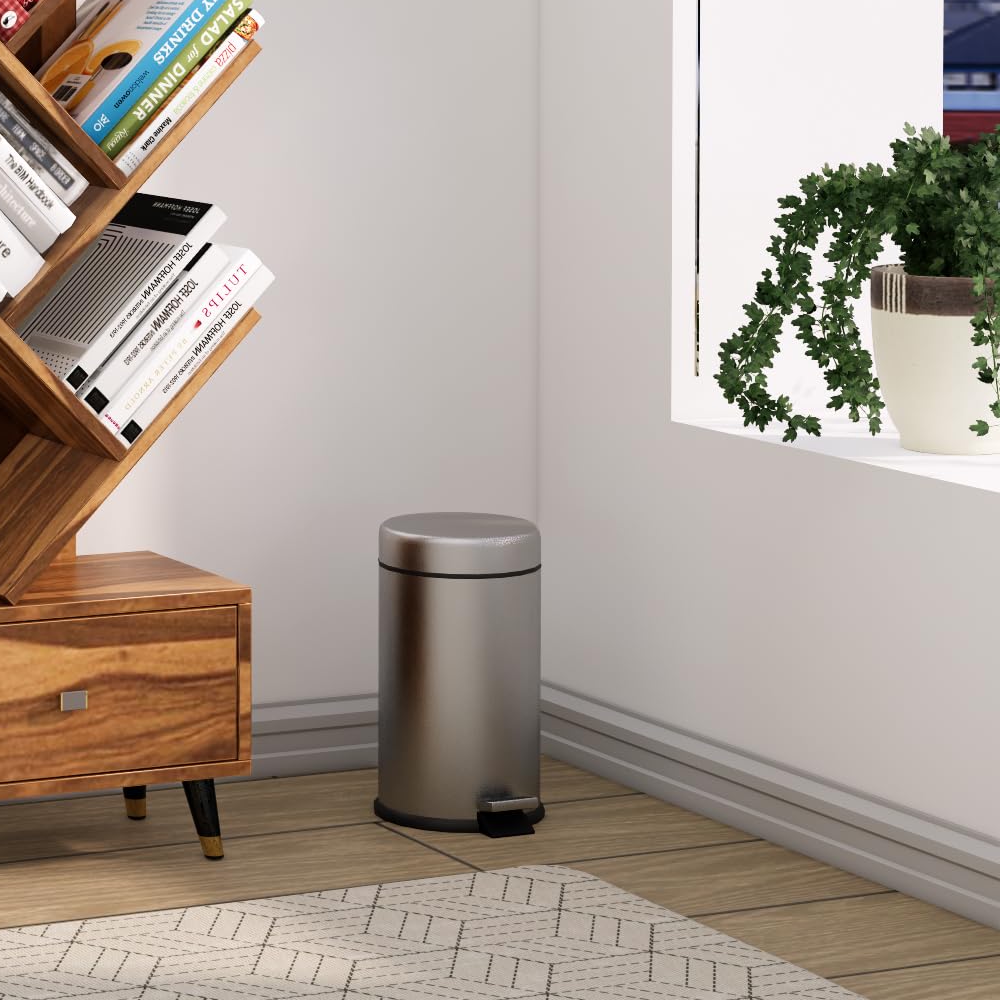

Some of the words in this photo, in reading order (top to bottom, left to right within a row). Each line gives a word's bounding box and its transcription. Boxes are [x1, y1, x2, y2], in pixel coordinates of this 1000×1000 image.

[153, 9, 204, 65] DRINKS
[185, 43, 200, 62] for
[214, 41, 238, 67] pizza
[113, 69, 150, 109] weldonowen
[132, 62, 187, 122] DINNER
[140, 134, 156, 151] Clark
[153, 116, 173, 138] Maxine
[4, 153, 18, 171] The
[14, 163, 28, 183] BIM
[24, 176, 55, 210] Handbook
